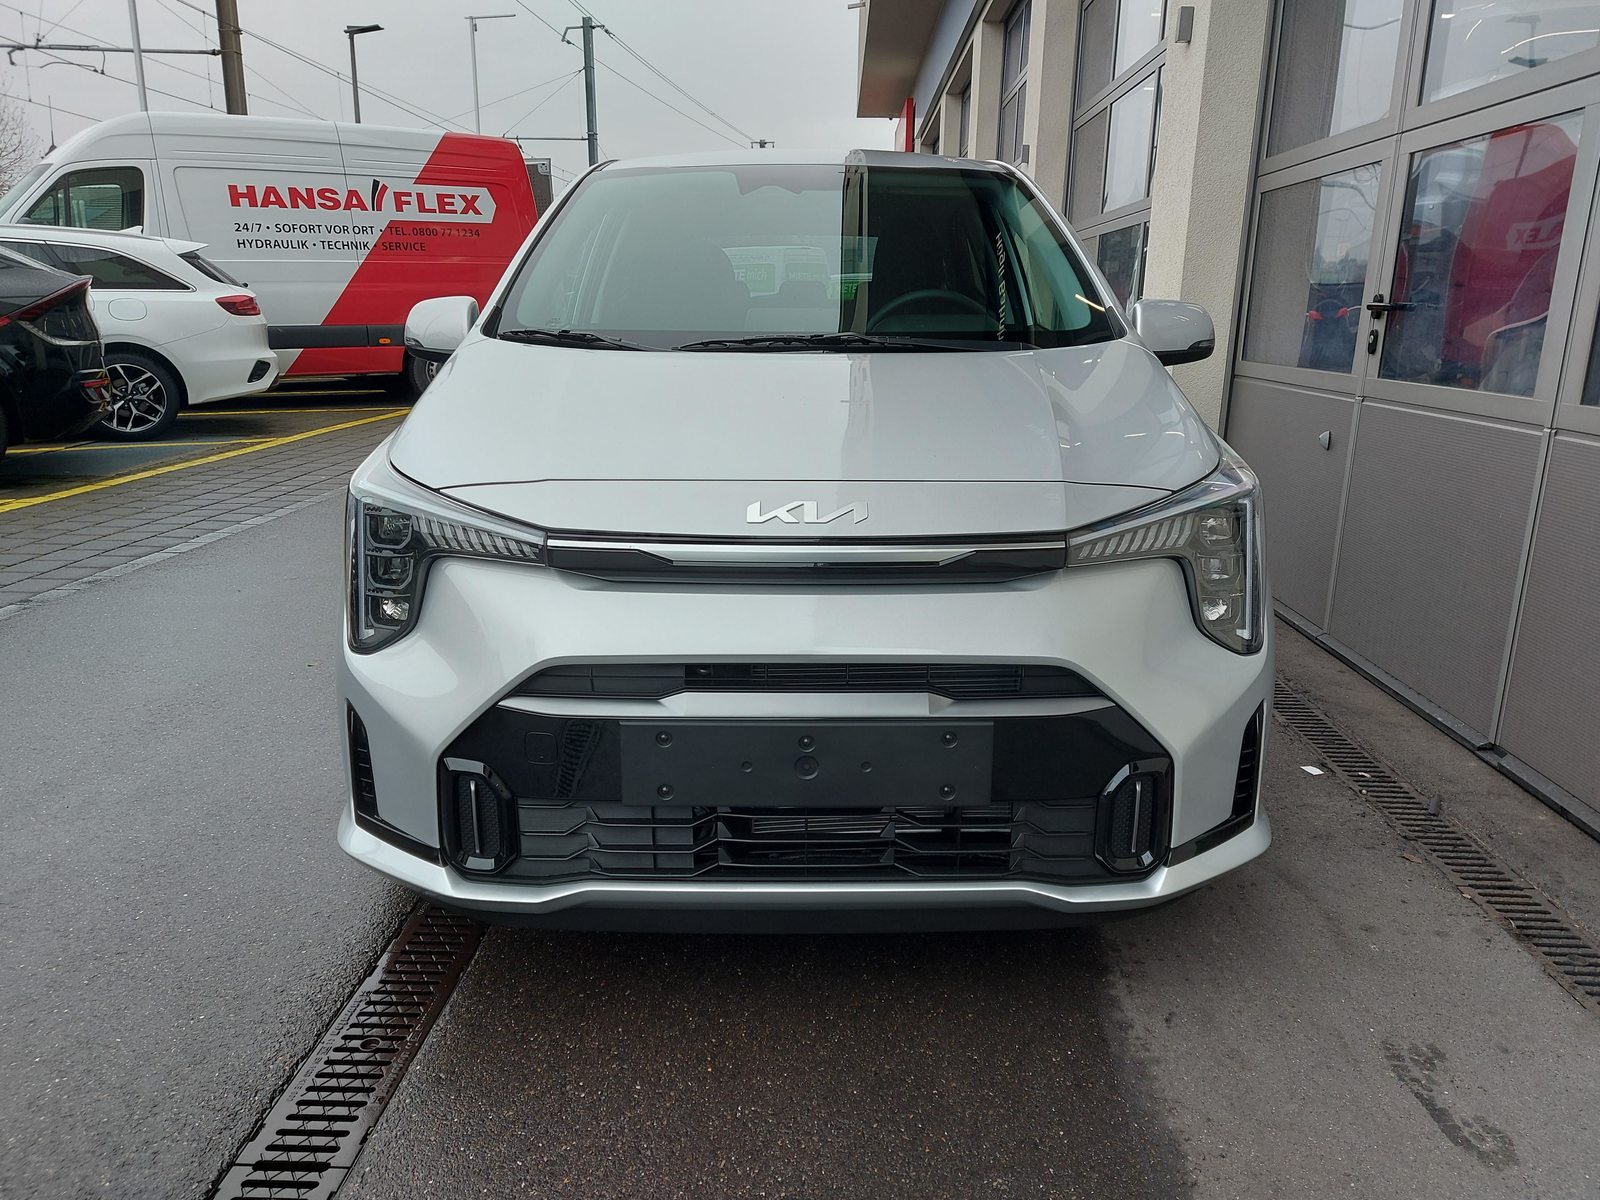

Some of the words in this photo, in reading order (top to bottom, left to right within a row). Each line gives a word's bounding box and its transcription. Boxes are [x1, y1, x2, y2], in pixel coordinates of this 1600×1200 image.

[227, 184, 369, 211] HANSA
[393, 191, 483, 216] FLEX
[234, 223, 262, 233] 24/7
[274, 223, 322, 234] SOFORT
[324, 225, 350, 235] VOR
[352, 225, 375, 235] ORT
[440, 228, 453, 237] 77
[456, 228, 480, 237] 1234
[236, 239, 310, 250] HYDRAULIK
[320, 240, 371, 251] TECHNIK
[381, 241, 427, 252] SERVICE
[747, 500, 868, 524] KIA
